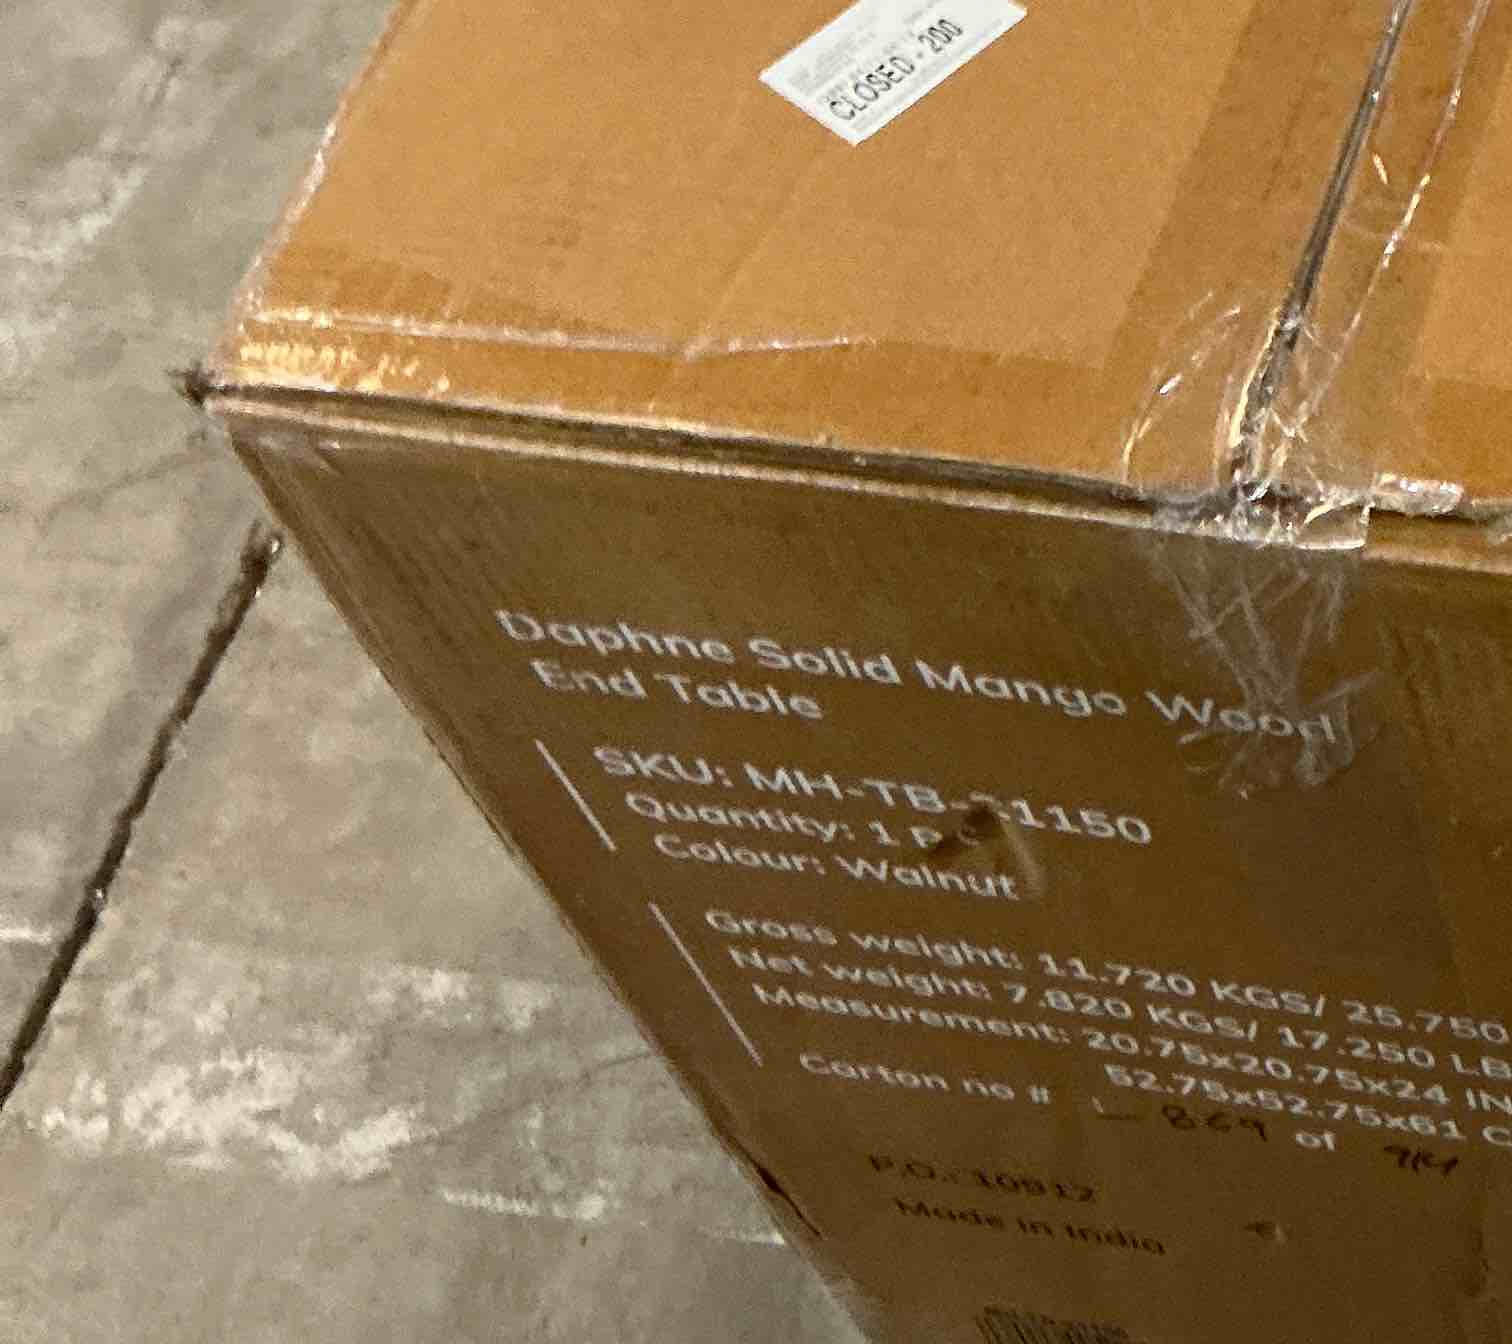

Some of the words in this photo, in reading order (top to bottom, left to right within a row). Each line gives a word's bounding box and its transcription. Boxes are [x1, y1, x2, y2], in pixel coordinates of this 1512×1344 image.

[829, 55, 916, 121] CLOSED
[918, 18, 964, 54] 200
[496, 608, 736, 663] Daphne
[748, 636, 903, 686] Solid
[914, 656, 1128, 718] Mango
[529, 658, 648, 699] End
[653, 671, 825, 719] Table
[593, 745, 735, 788] SKU:
[625, 791, 856, 843] Quantity:
[868, 820, 900, 846] 1
[654, 833, 826, 874] Colour:
[833, 855, 1021, 901] Walnut
[704, 909, 838, 945] Gross
[849, 932, 1024, 970] weight:
[1038, 951, 1197, 998] 11.720
[1208, 977, 1326, 1017] KGS/
[1341, 999, 1510, 1045] 25.750
[727, 944, 814, 977] Net
[822, 961, 994, 1001] weight:
[1003, 981, 1133, 1021] 7.820
[1146, 1002, 1258, 1042] KGS/
[1277, 1024, 1436, 1071] 17.250
[751, 981, 1072, 1045] Measurement:
[1082, 1026, 1451, 1105] 20.75x20.75x24
[799, 1054, 950, 1091] Carton
[961, 1078, 1016, 1101] no
[1295, 1130, 1337, 1153] of
[893, 1196, 1004, 1229] Made
[1015, 1216, 1056, 1238] in
[1062, 1223, 1167, 1257] India
